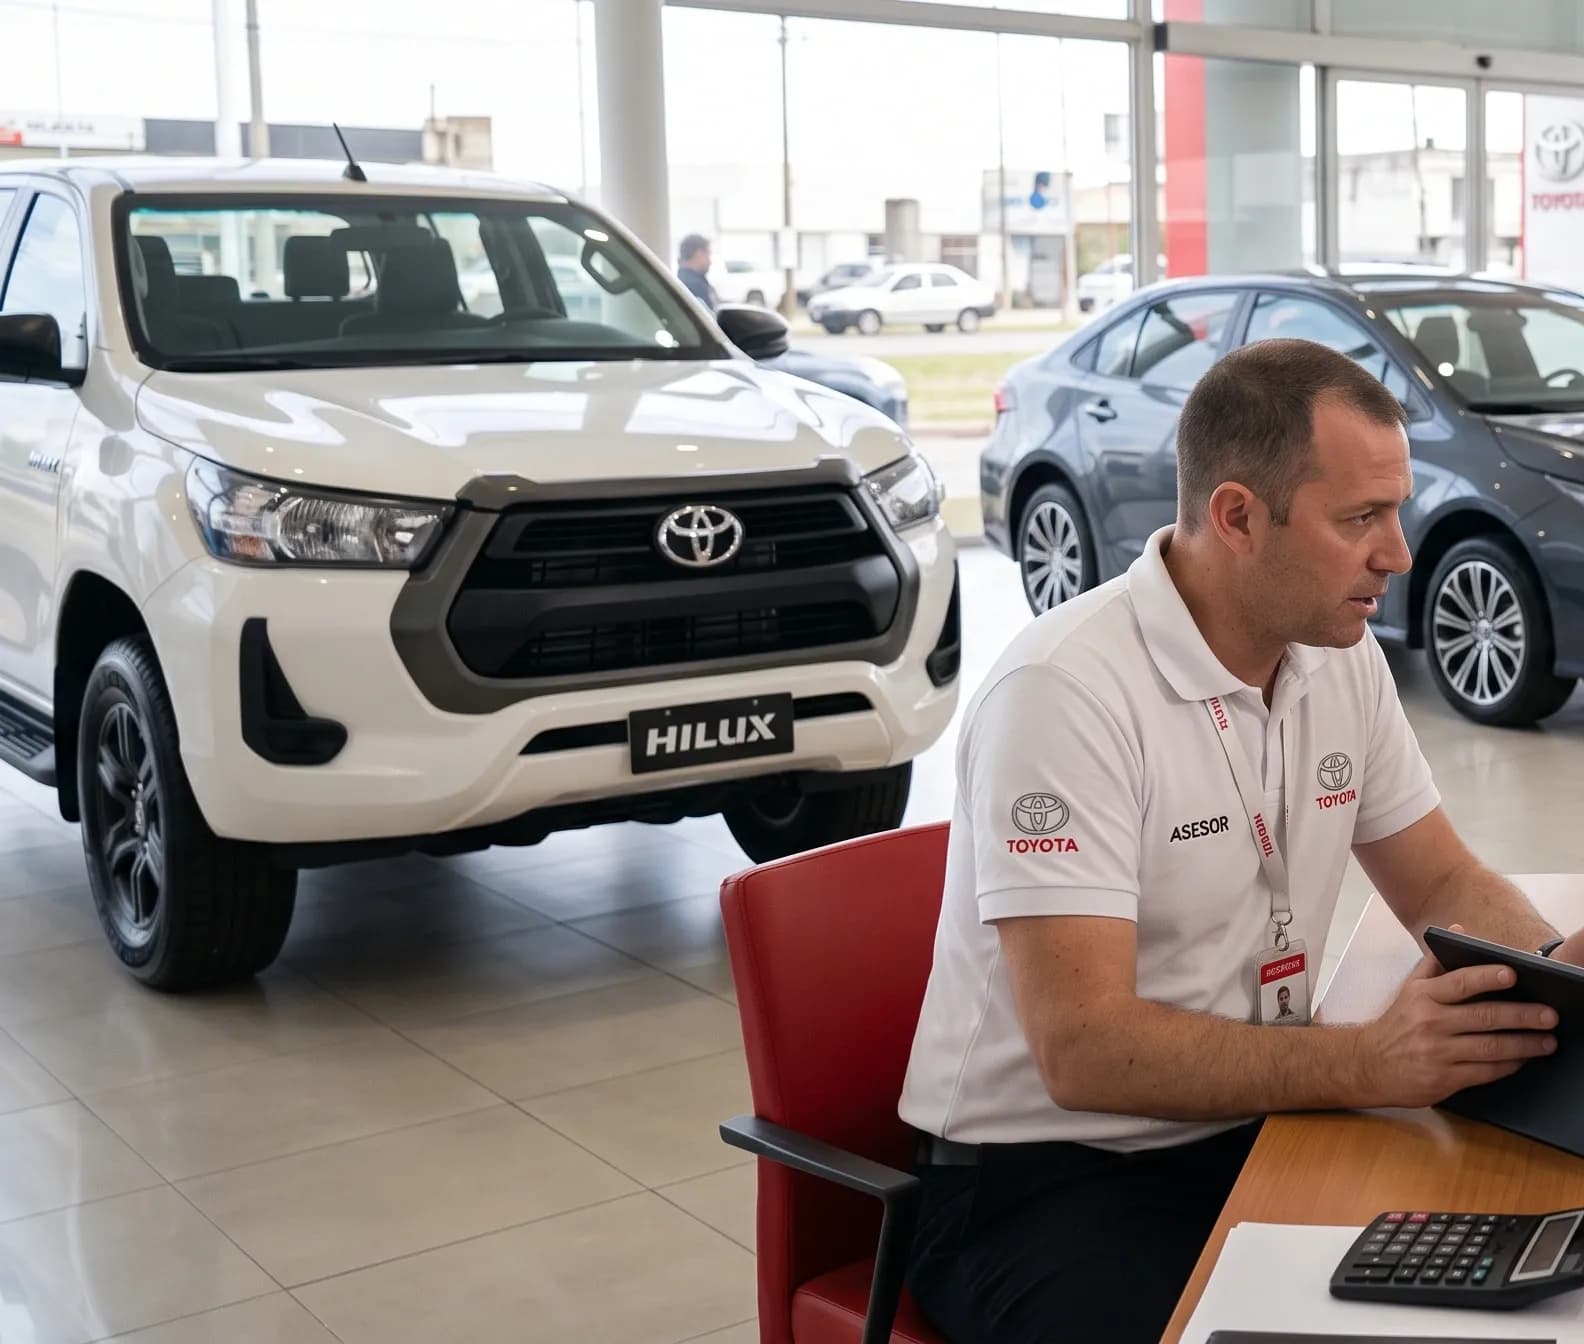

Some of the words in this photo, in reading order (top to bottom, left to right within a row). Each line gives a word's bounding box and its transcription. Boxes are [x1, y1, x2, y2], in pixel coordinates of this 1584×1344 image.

[645, 712, 776, 757] HILUX
[1316, 789, 1357, 810] TOYOTA
[1169, 815, 1229, 843] ASESOR
[1006, 838, 1079, 854] TOYOTA
